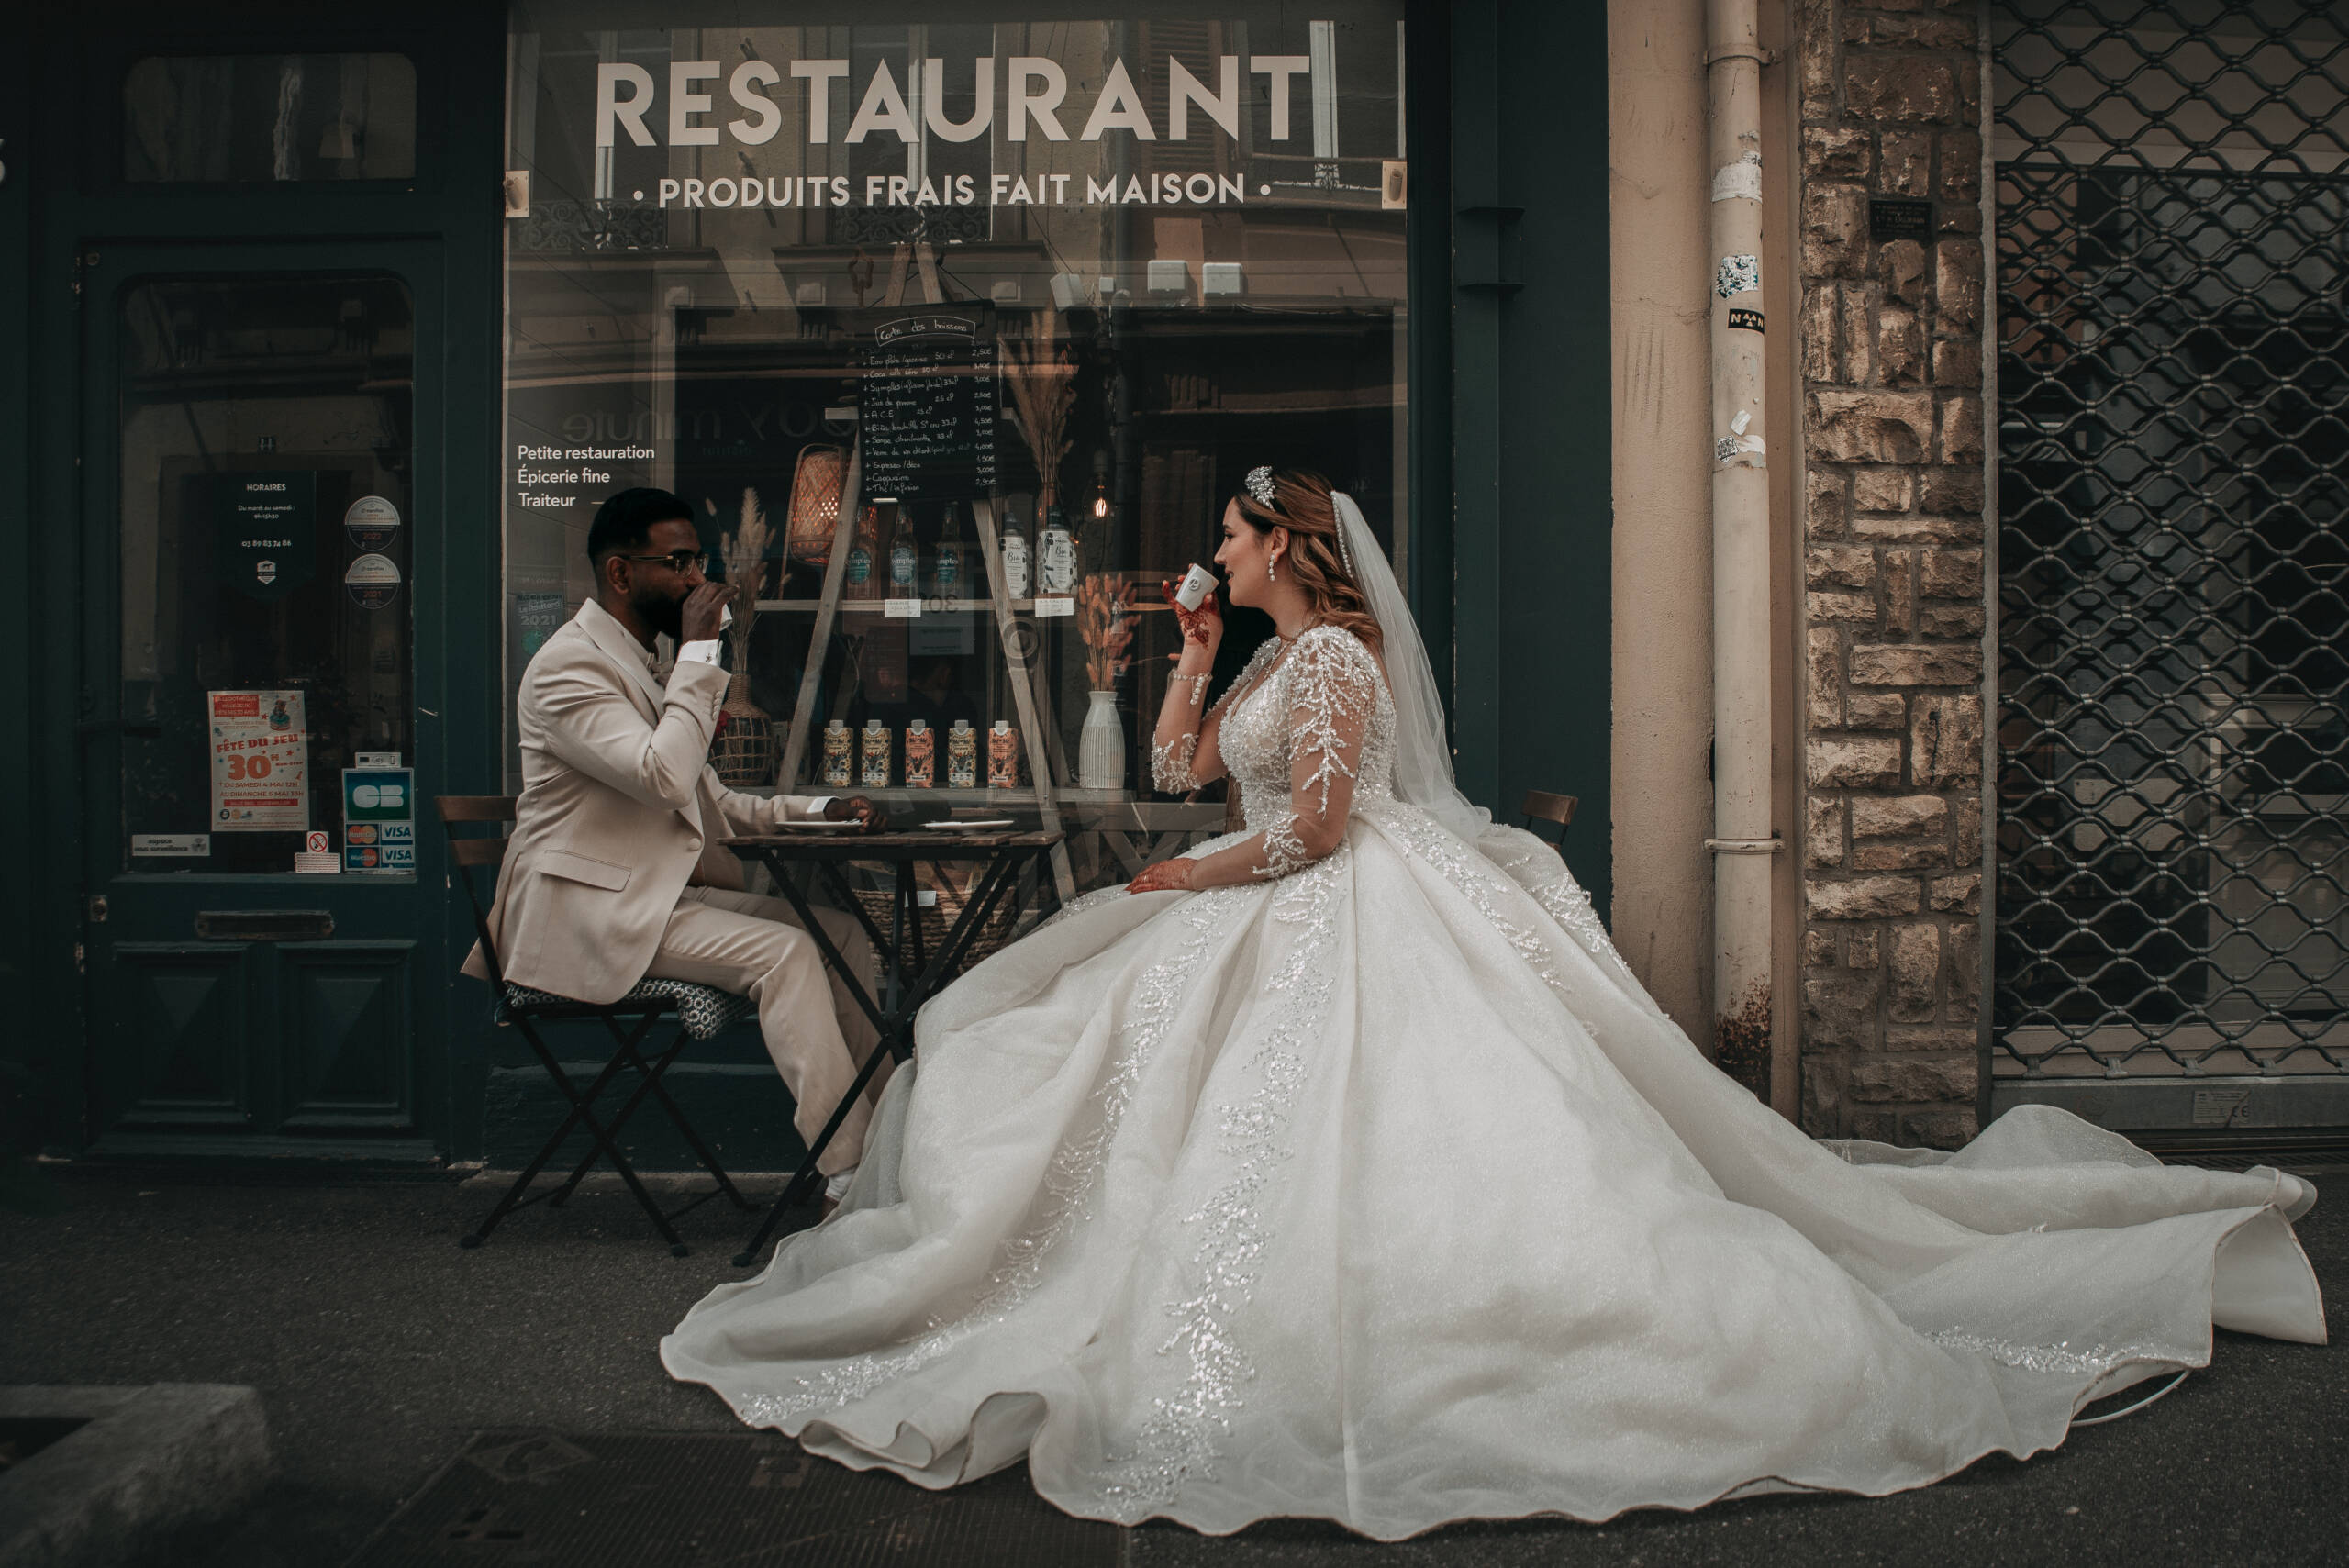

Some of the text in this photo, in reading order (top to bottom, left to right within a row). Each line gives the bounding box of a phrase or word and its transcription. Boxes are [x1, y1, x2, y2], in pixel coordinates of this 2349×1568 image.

[597, 55, 1310, 148] RESTAURANT
[659, 172, 1244, 208] PRODUITS FRAIS FAIT MAISON
[911, 321, 926, 332] des
[934, 318, 967, 332] boissons
[518, 444, 655, 460] Petite restauration
[518, 463, 611, 488] Épicerie fine
[246, 484, 287, 492] HORAIRES
[518, 492, 576, 507] Traiteur
[252, 539, 262, 548] 89
[521, 615, 557, 626] 2021
[217, 733, 299, 752] FÊTE DU JEU
[385, 827, 411, 837] VISA
[386, 850, 412, 860] VISA
